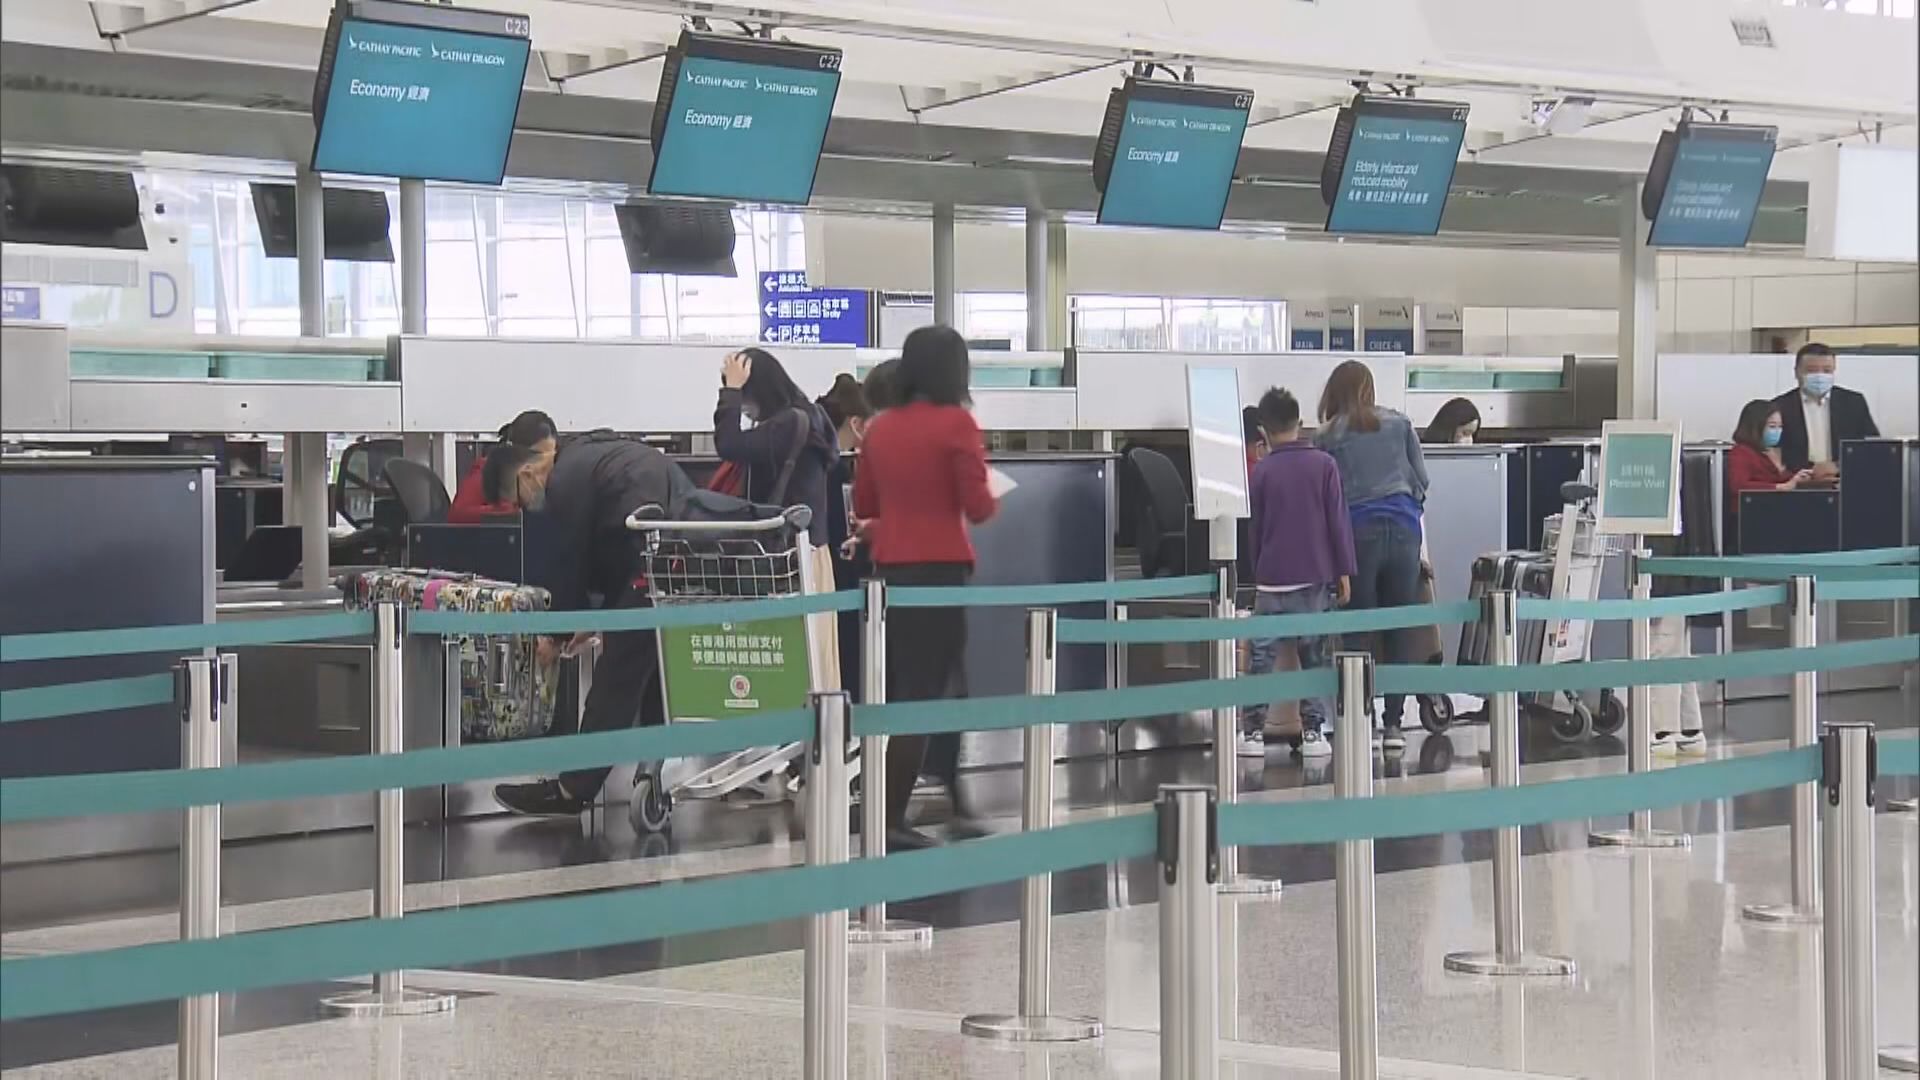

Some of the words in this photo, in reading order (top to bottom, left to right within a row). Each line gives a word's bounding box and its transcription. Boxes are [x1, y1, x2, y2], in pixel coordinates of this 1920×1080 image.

[505, 17, 529, 36] C23
[358, 40, 391, 54] CATHAY
[391, 45, 422, 57] PACIFIC
[440, 50, 472, 62] CATHAY
[472, 53, 505, 66] DRAGON
[350, 79, 406, 102] Economy
[694, 74, 721, 86] CATHAY
[721, 78, 750, 89] PACIFIC
[763, 82, 789, 93] CATHAY
[789, 85, 818, 97] DRAGON
[685, 109, 732, 130] Economy
[1127, 147, 1165, 165] Economy
[149, 271, 178, 318] D
